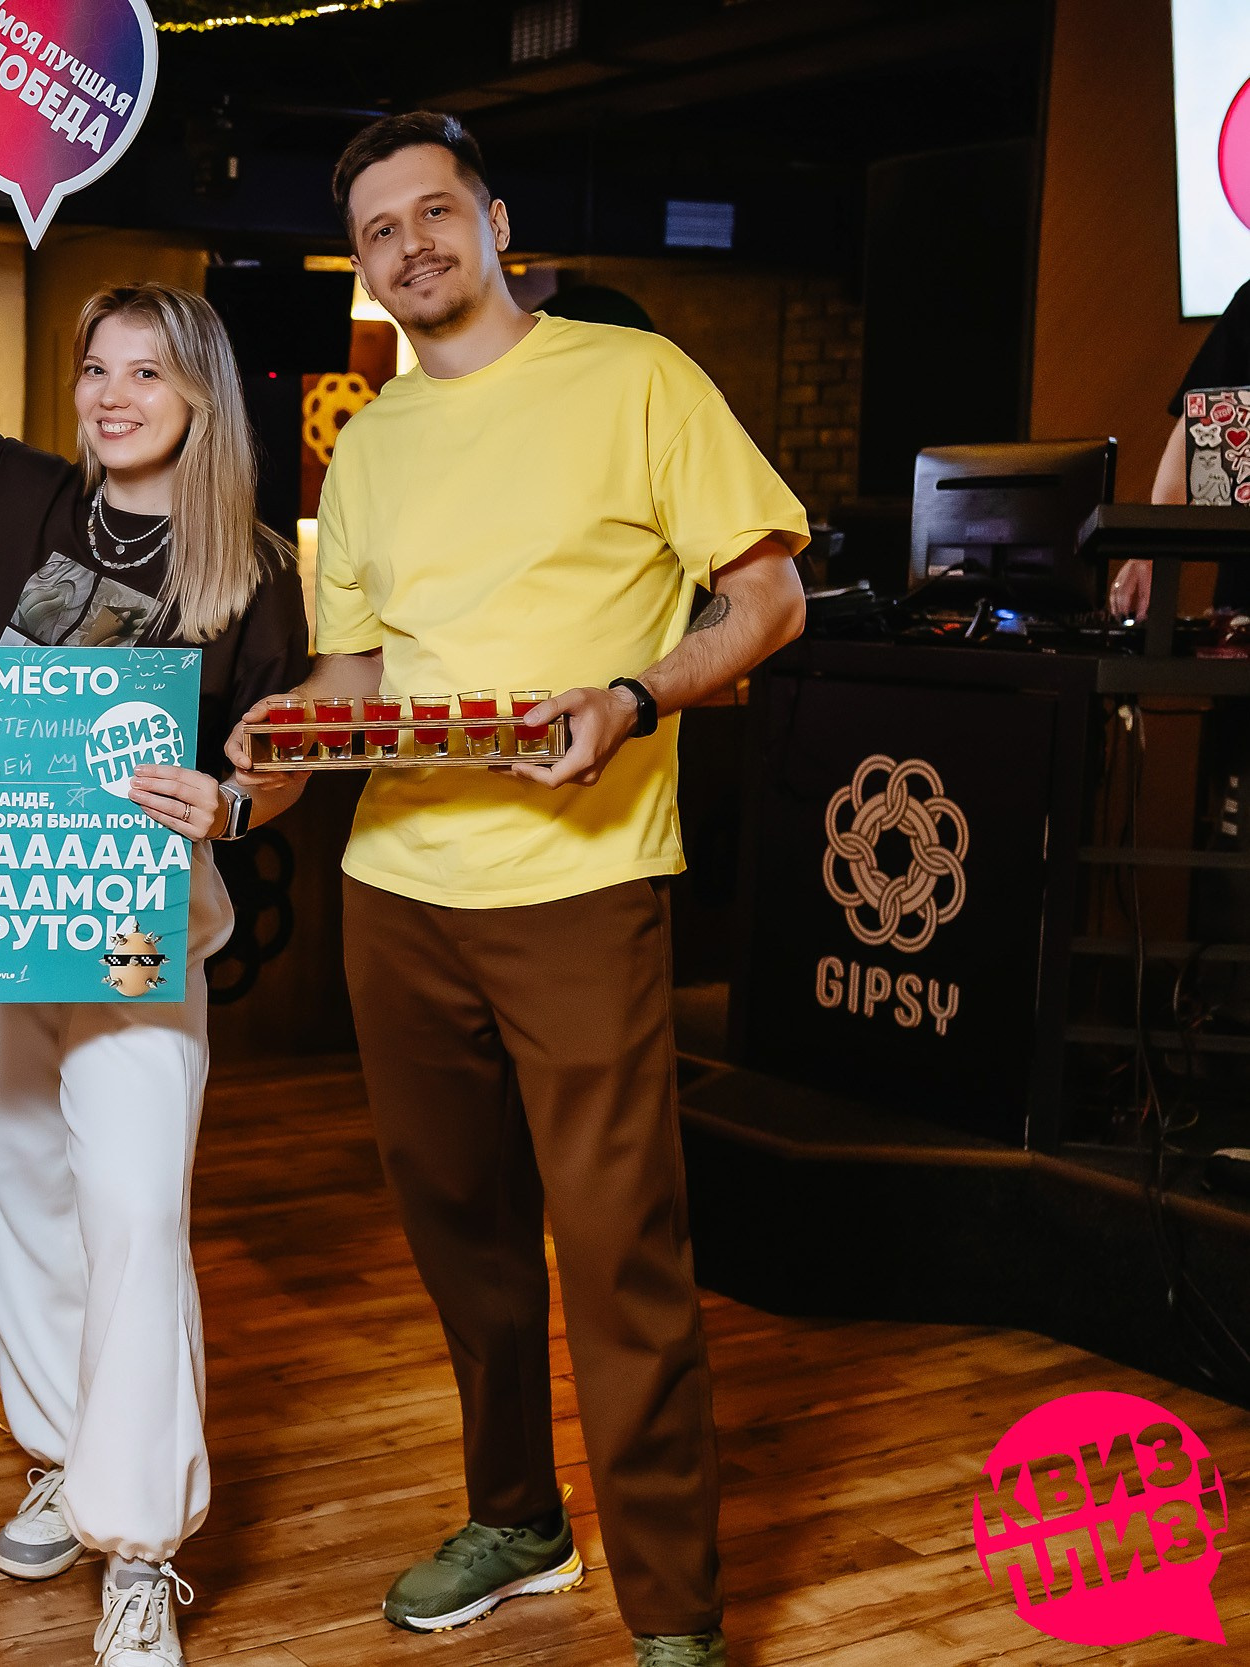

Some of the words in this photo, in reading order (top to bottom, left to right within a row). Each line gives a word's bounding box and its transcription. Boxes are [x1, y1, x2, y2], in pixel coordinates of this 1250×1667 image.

[38, 41, 134, 117] ЛУЧШАЯ
[47, 814, 102, 828] БЫЛА
[106, 814, 164, 829] ПОЧТ
[816, 956, 960, 1036] GIPSY
